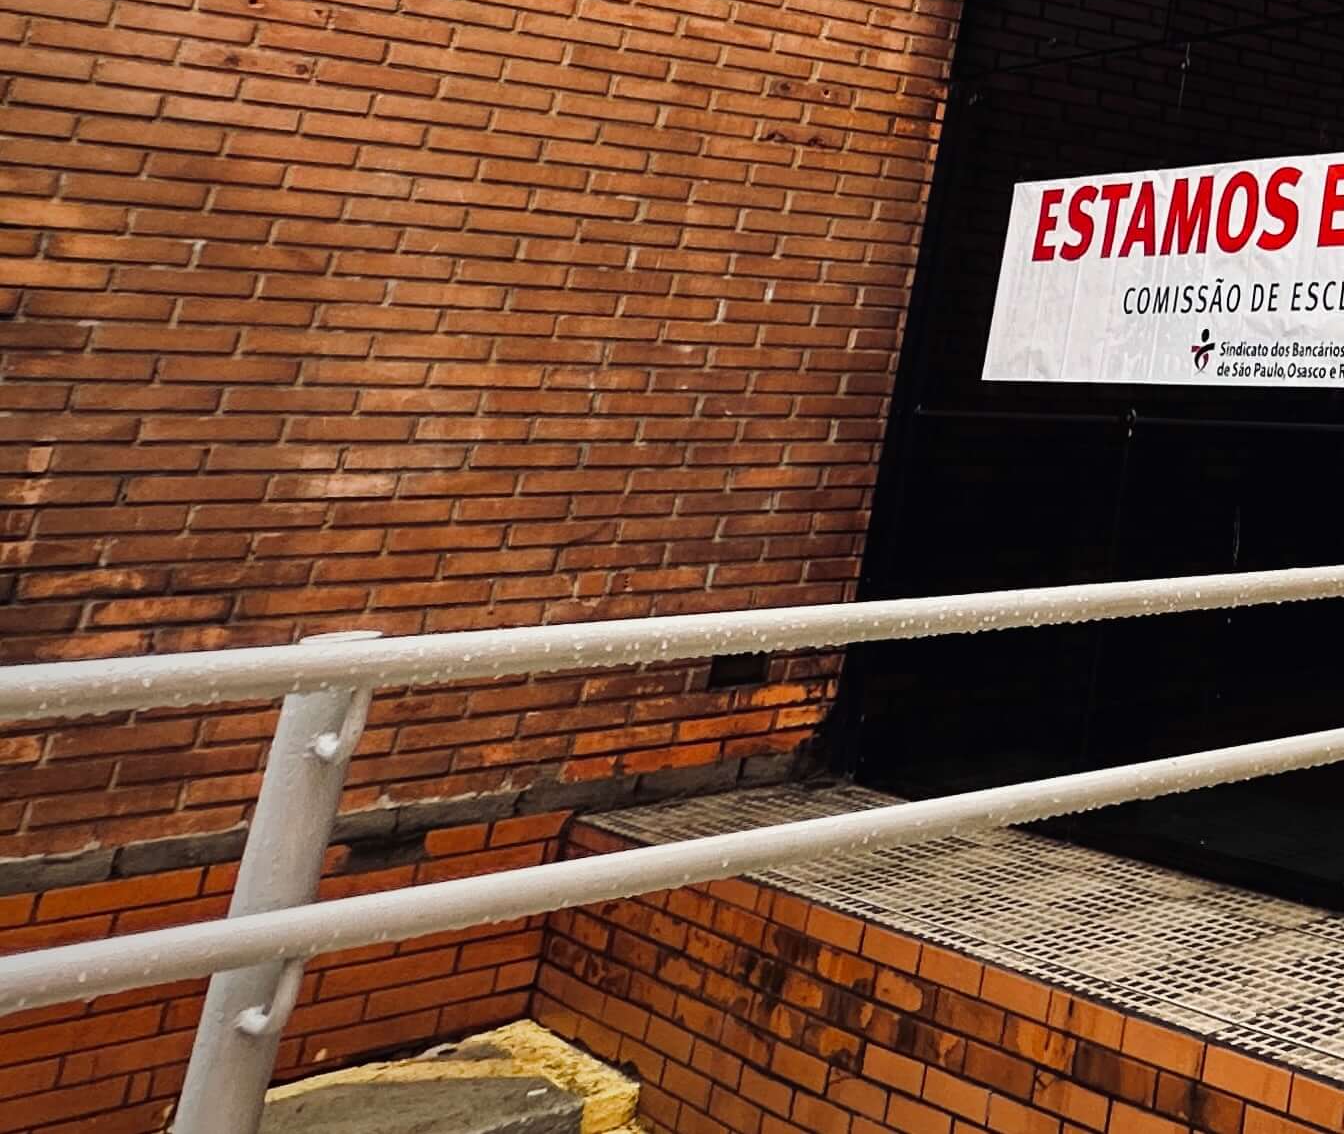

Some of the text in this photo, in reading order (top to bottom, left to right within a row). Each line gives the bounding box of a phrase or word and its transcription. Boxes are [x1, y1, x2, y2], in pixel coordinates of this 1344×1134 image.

[1032, 167, 1303, 262] ESTAMOS
[1123, 278, 1241, 314] COMISSÃO
[1251, 283, 1280, 313] DE
[1219, 341, 1268, 357] Sindicato
[1271, 341, 1290, 357] dos
[1292, 342, 1344, 358] Bancários
[1217, 362, 1230, 377] de
[1231, 363, 1251, 377] São
[1287, 363, 1326, 379] Osasco
[1329, 365, 1336, 379] e
